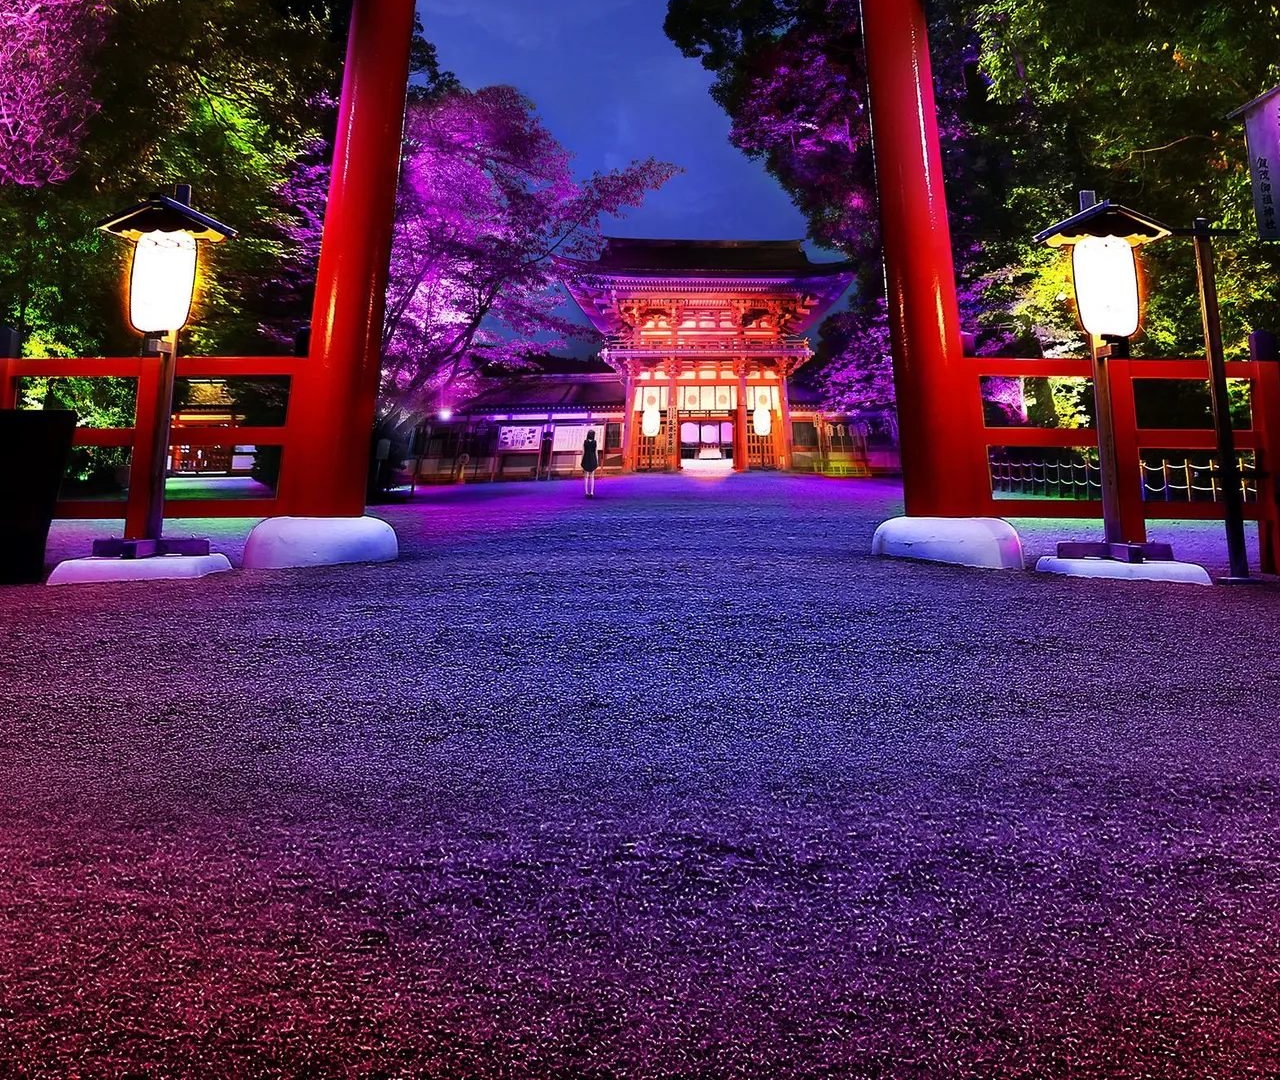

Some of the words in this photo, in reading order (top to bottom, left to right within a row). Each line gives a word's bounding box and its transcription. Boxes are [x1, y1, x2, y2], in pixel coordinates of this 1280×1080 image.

[1256, 156, 1277, 230] 賀茂御祖神社
